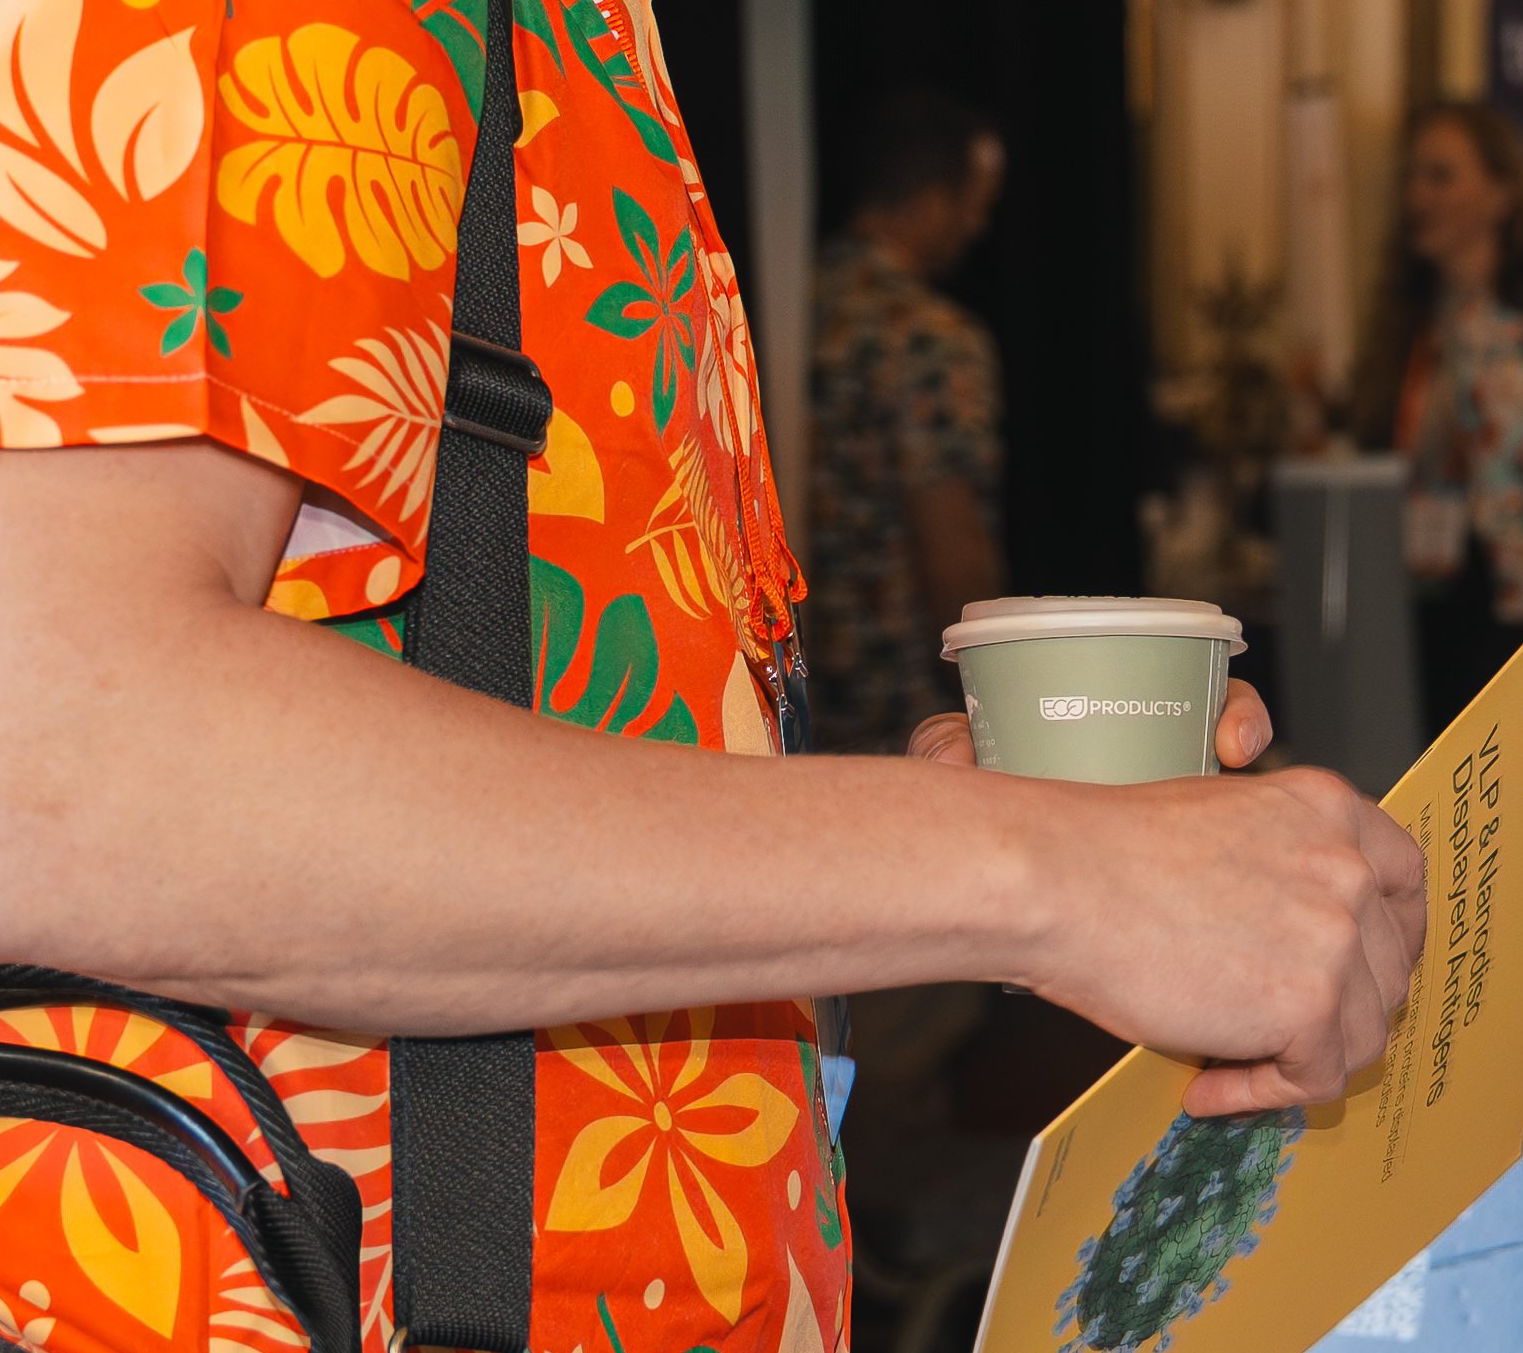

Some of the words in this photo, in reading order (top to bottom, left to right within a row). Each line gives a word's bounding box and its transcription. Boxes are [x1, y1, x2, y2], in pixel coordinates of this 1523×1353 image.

[1479, 720, 1501, 810] VLP
[1479, 815, 1500, 856] &
[1447, 752, 1475, 950] Displayed
[1463, 846, 1499, 1028] Nanodisc
[1427, 949, 1469, 1108] Antigens
